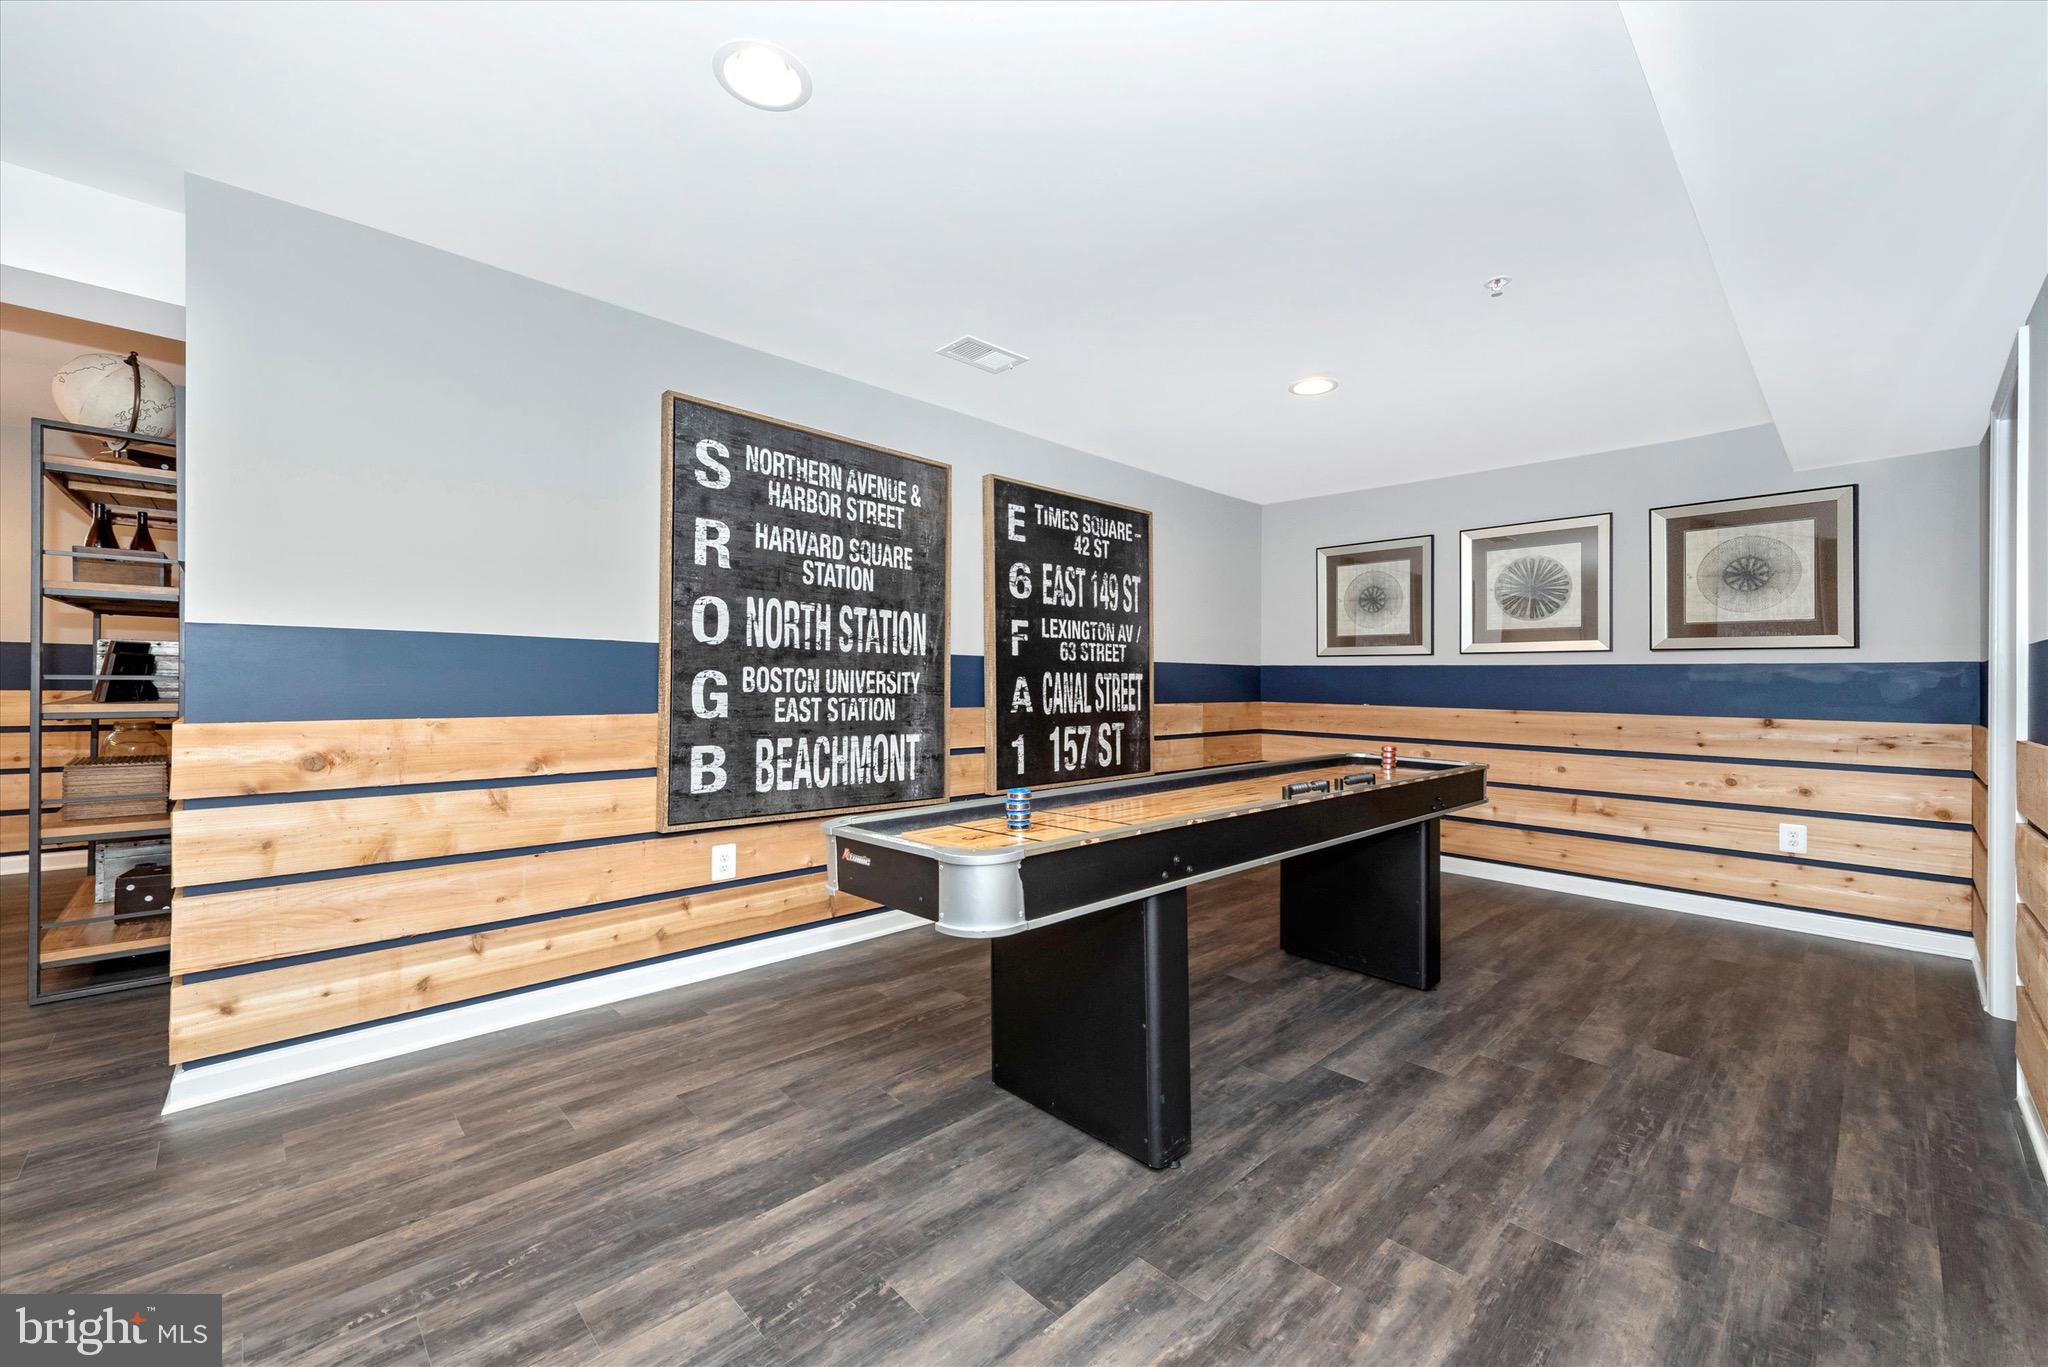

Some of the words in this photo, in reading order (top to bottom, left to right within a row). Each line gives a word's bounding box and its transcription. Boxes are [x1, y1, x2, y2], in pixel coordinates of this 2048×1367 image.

[694, 439, 731, 490] S
[745, 444, 843, 491] NORTHERN
[846, 469, 907, 504] AVENUE
[910, 484, 922, 508] &
[768, 480, 842, 519] HARBOR
[846, 496, 905, 530] STREET
[1007, 503, 1027, 542] E
[1034, 503, 1079, 532] TIMES
[1082, 513, 1133, 542] SQUARE
[694, 517, 731, 569] R
[755, 522, 844, 561] HARVARD
[849, 537, 913, 571] SQUARE
[1073, 535, 1091, 556] 42
[1093, 538, 1110, 559] ST
[802, 559, 874, 592] STATION
[1008, 562, 1032, 599] 6
[1042, 562, 1086, 608] EAST
[1090, 570, 1119, 612] 149
[1122, 573, 1142, 613] ST
[691, 595, 730, 645] O
[746, 596, 831, 651] NORTH
[838, 604, 927, 656] STATION
[1011, 619, 1029, 656] F
[1041, 617, 1115, 642] LEXINGTON
[1117, 624, 1134, 643] AV
[1059, 641, 1077, 661] 63
[1080, 642, 1127, 662] STREET
[691, 669, 729, 719] G
[825, 668, 921, 694] UNIVERSITY
[1010, 676, 1034, 713] A
[1042, 671, 1092, 715] CANAL
[1095, 672, 1143, 713] STREET
[774, 697, 822, 723] EAST
[827, 697, 896, 722] STATION
[755, 733, 921, 793] BEACHMONT
[1011, 733, 1025, 775] 1
[1049, 725, 1092, 772] 157
[1098, 722, 1125, 768] ST
[690, 745, 726, 794] B
